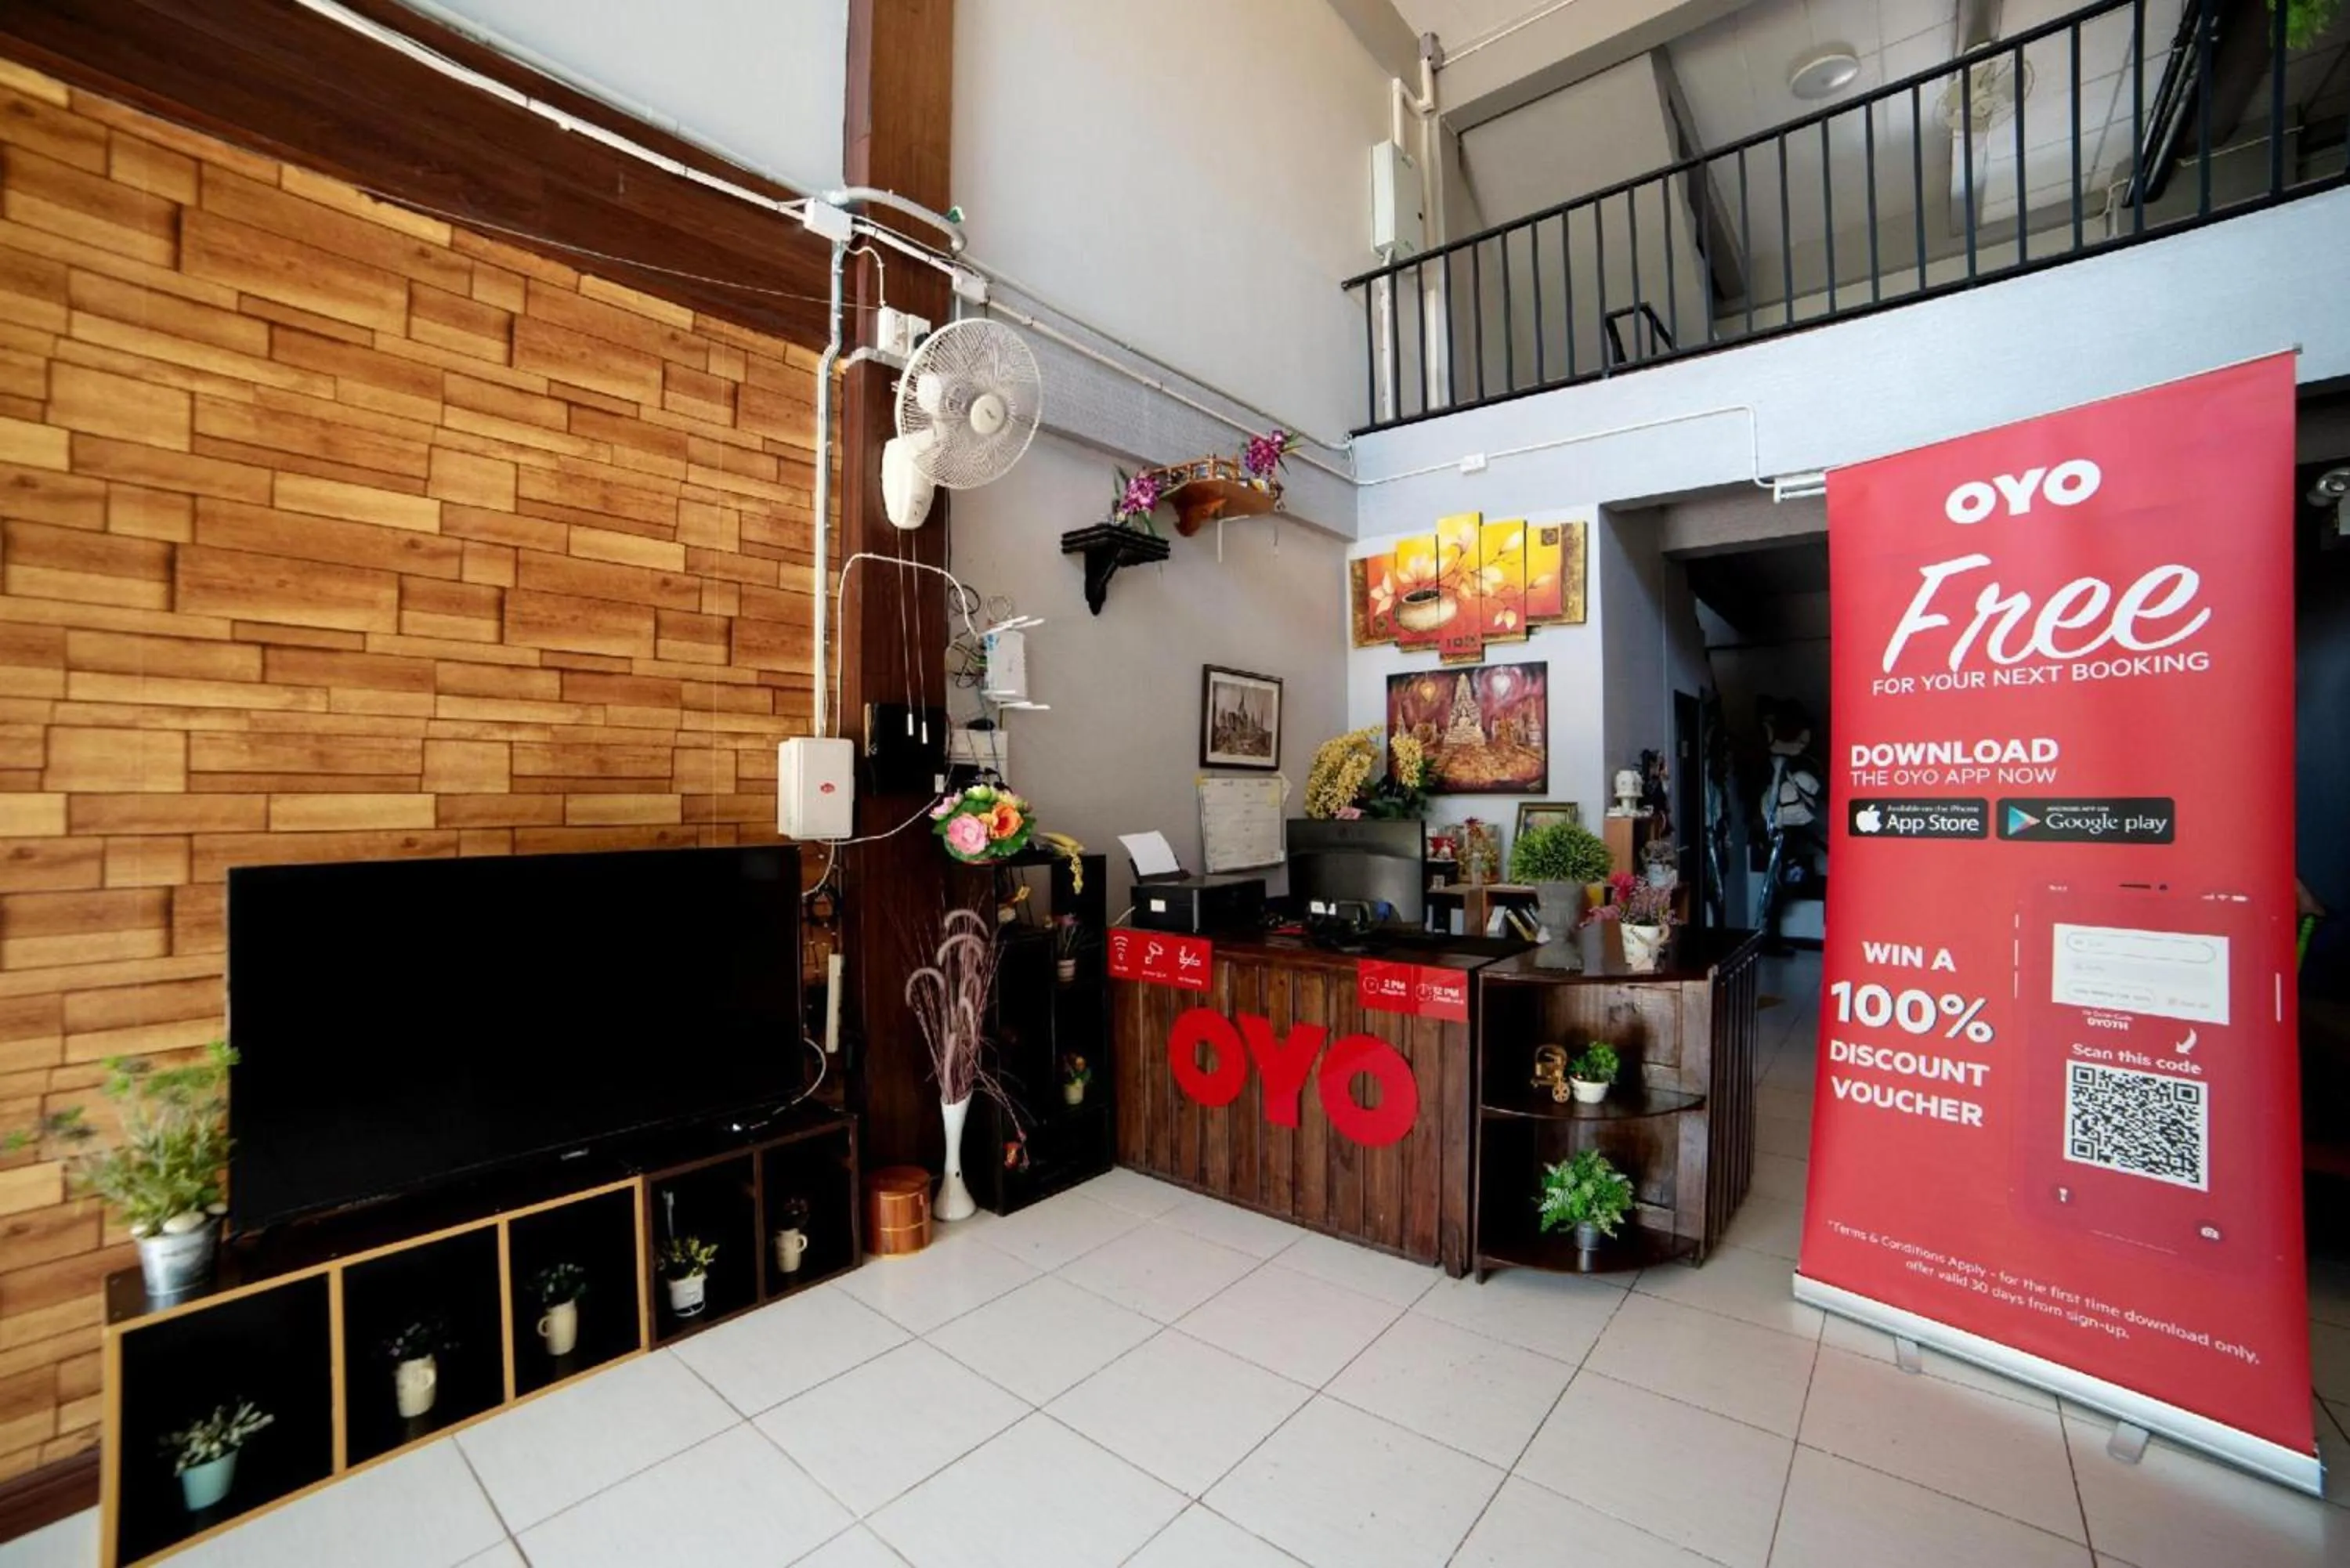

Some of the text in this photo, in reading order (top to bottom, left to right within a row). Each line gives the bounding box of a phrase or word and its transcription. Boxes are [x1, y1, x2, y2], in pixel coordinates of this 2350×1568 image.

[1945, 459, 2101, 524] OYO
[1882, 553, 2211, 673] Free
[1872, 652, 2210, 695] FOR YOUR NEXT BOOKING
[1850, 739, 2059, 767] DOWNLOAD
[1850, 768, 2057, 786] THE OYO APP NOW
[1886, 814, 1979, 833] App Store
[2045, 813, 2167, 834] Google play
[1862, 941, 1956, 972] WIN A
[1444, 987, 1459, 997] PM
[1831, 981, 1994, 1042] 100%
[1168, 1007, 1420, 1149] OYO
[1830, 1039, 1990, 1087] DISCOUNT
[2071, 1042, 2202, 1075] Scan this code
[1831, 1075, 1983, 1127] VOUCHER
[1869, 1233, 1878, 1244] &
[1881, 1236, 1945, 1264] Conditions
[1947, 1257, 1987, 1277] Apply
[1998, 1270, 2018, 1286] for
[2023, 1279, 2047, 1294] the
[2050, 1284, 2081, 1305] first
[2084, 1297, 2120, 1317] time
[2124, 1310, 2209, 1346] download
[2214, 1339, 2261, 1366] only.
[1906, 1259, 2130, 1340] offer valid 30 days from sign-up.
